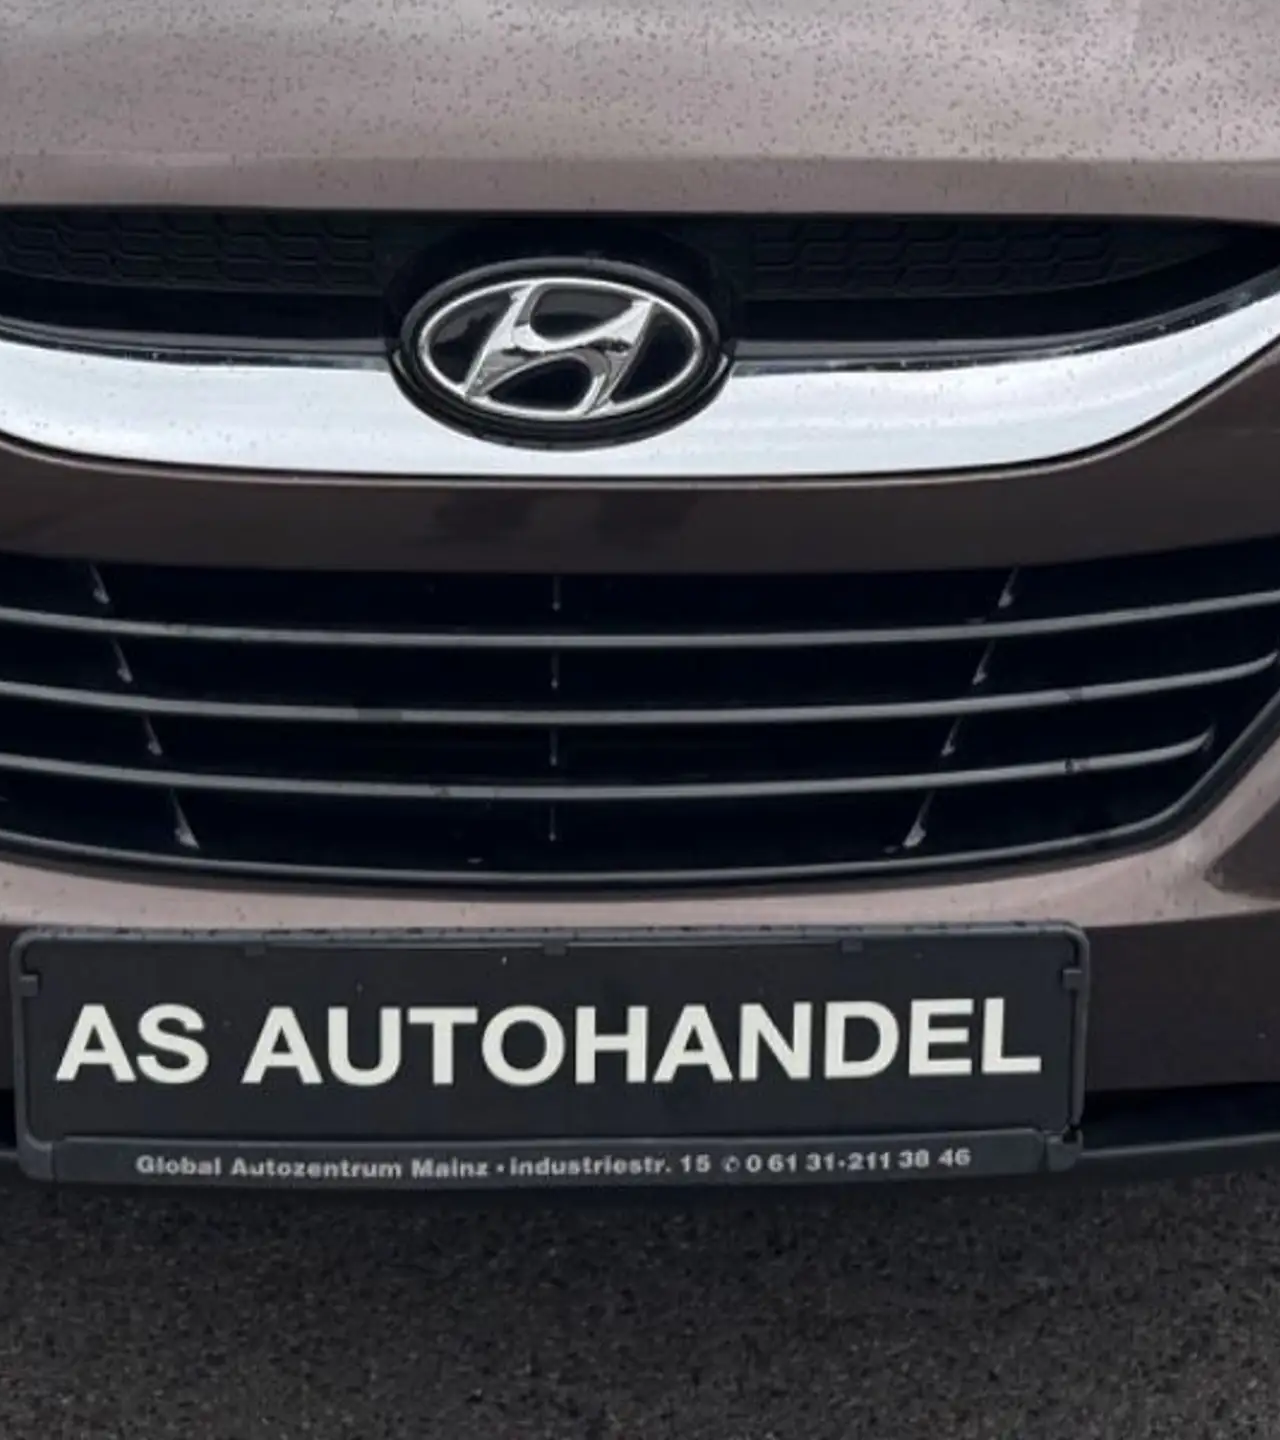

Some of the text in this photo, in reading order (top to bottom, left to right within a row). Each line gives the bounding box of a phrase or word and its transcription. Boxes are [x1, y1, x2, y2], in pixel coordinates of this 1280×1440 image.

[55, 997, 1043, 1086] AS AUTOHANDEL
[135, 1155, 221, 1176] Global
[231, 1157, 402, 1178] Autozentrum
[411, 1157, 489, 1179] Mainz
[681, 1153, 711, 1174] 15
